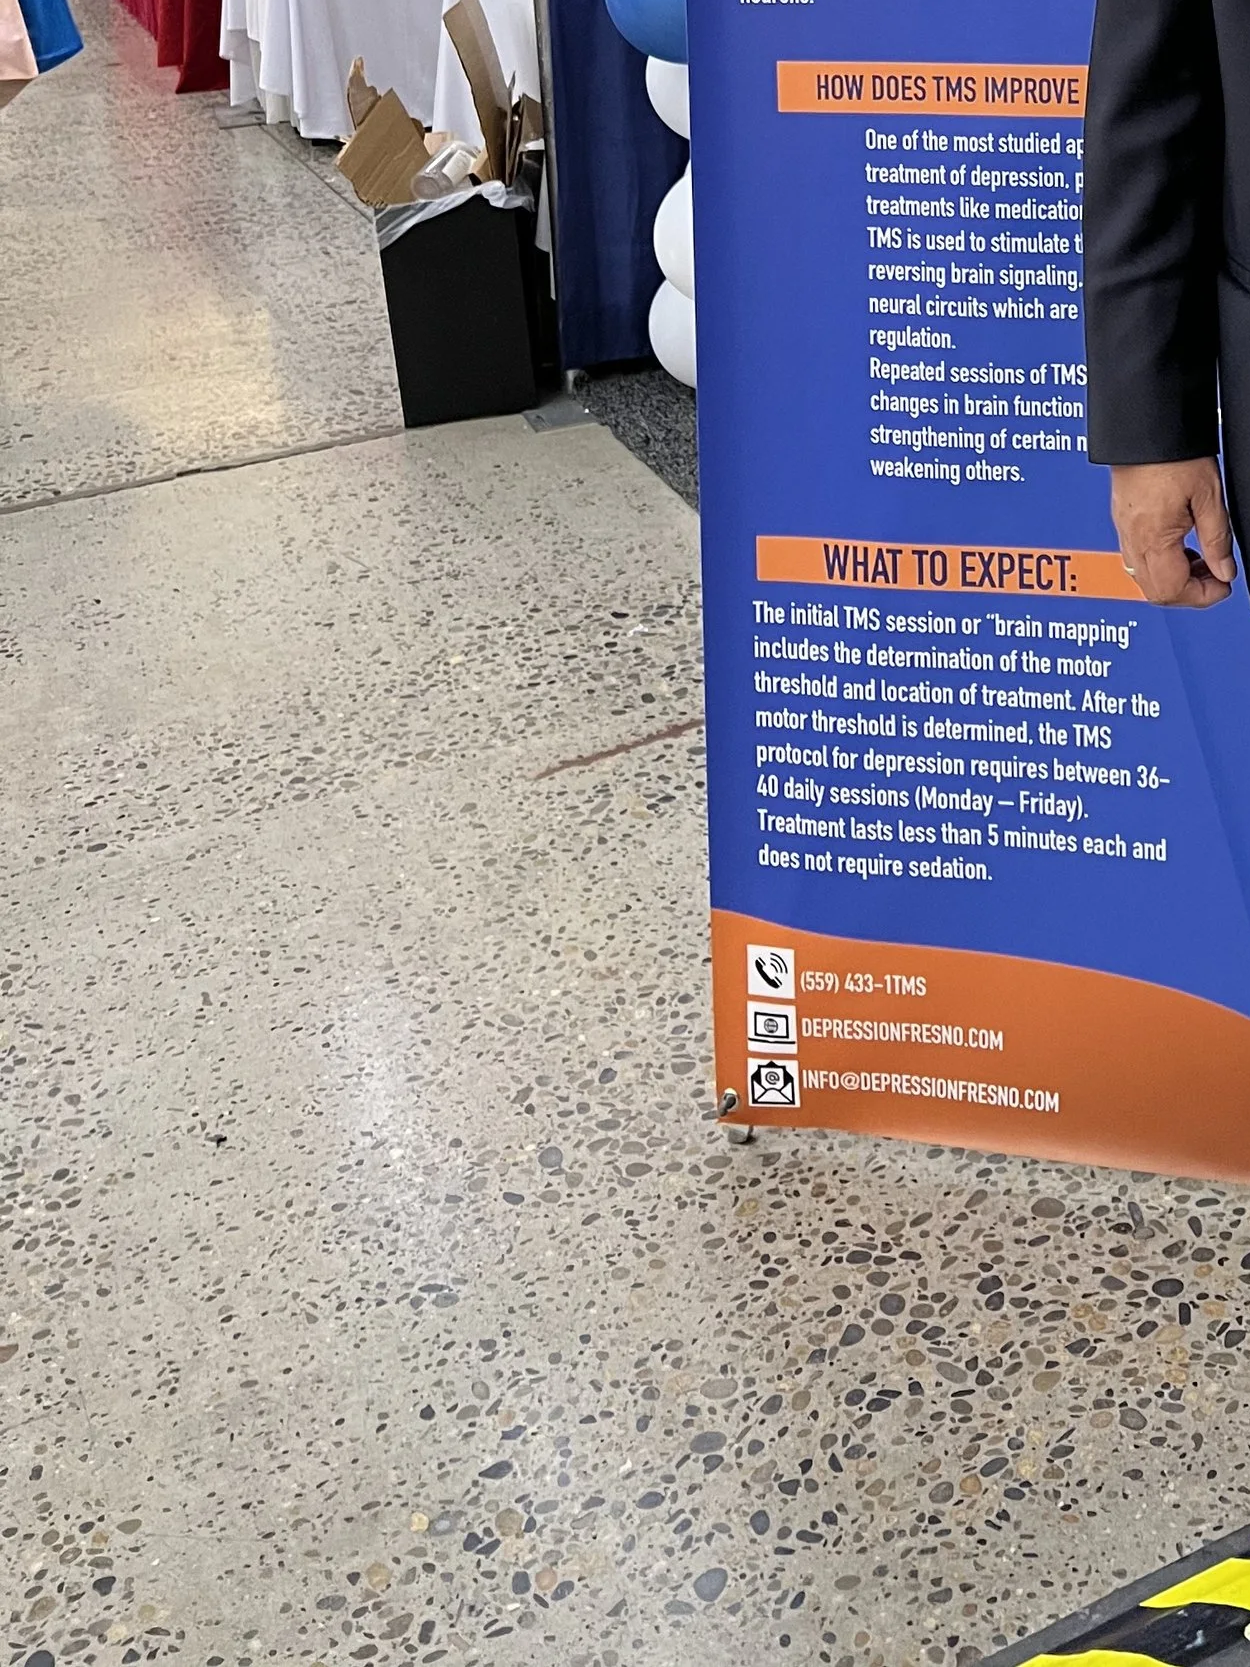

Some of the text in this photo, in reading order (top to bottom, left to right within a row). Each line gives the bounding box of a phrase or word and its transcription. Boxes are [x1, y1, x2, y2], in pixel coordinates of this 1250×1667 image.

[816, 74, 1080, 105] HOW DOES TMS IMPROVE
[865, 128, 898, 150] One
[902, 129, 919, 151] of
[921, 129, 949, 151] the
[953, 132, 995, 153] most
[998, 132, 1061, 154] studied
[864, 162, 947, 185] treatment
[949, 164, 967, 186] of
[865, 194, 955, 218] treatments
[959, 196, 990, 219] like
[866, 226, 902, 249] TMS
[906, 227, 922, 250] is
[925, 229, 965, 252] used
[968, 231, 986, 252] to
[990, 231, 1070, 254] stimulate
[868, 260, 946, 289] reversing
[950, 261, 995, 285] brain
[869, 293, 1079, 320] neural circuits which are
[869, 325, 956, 352] regulation.
[870, 356, 1088, 386] Repeated sessions of TMS
[870, 389, 1084, 419] changes in brain function
[870, 424, 985, 454] strengthening
[990, 428, 1008, 449] of
[1011, 429, 1072, 451] certain
[870, 456, 1025, 486] weakening others.
[822, 543, 1077, 595] WHAT TO EXPECT:
[752, 600, 785, 624] The
[790, 601, 840, 628] initial
[843, 605, 881, 631] TMS
[885, 610, 957, 634] session
[961, 617, 982, 635] or
[754, 635, 1112, 678] includes the determination of the motor
[753, 670, 1160, 718] threshold and location of treatment. After the
[755, 707, 809, 730] motor
[811, 709, 897, 737] threshold
[901, 714, 918, 738] is
[1037, 721, 1068, 746] the
[1072, 723, 1112, 749] TMS
[756, 742, 829, 771] protocol
[831, 745, 859, 770] for
[863, 747, 965, 778] depression
[970, 755, 1049, 784] requires
[1053, 757, 1131, 787] between
[756, 773, 1089, 823] 40 daily sessions (Monday Friday).
[756, 808, 1167, 862] Treatment lasts less than 5 minutes each and
[758, 843, 993, 881] does not require sedation.
[800, 970, 927, 997] (559) 433-1TMS
[801, 1017, 1004, 1051] DEPRESSIONFRESNO.COM
[802, 1069, 1060, 1113] INFO@DEPRESSIONFRESNO.COM
